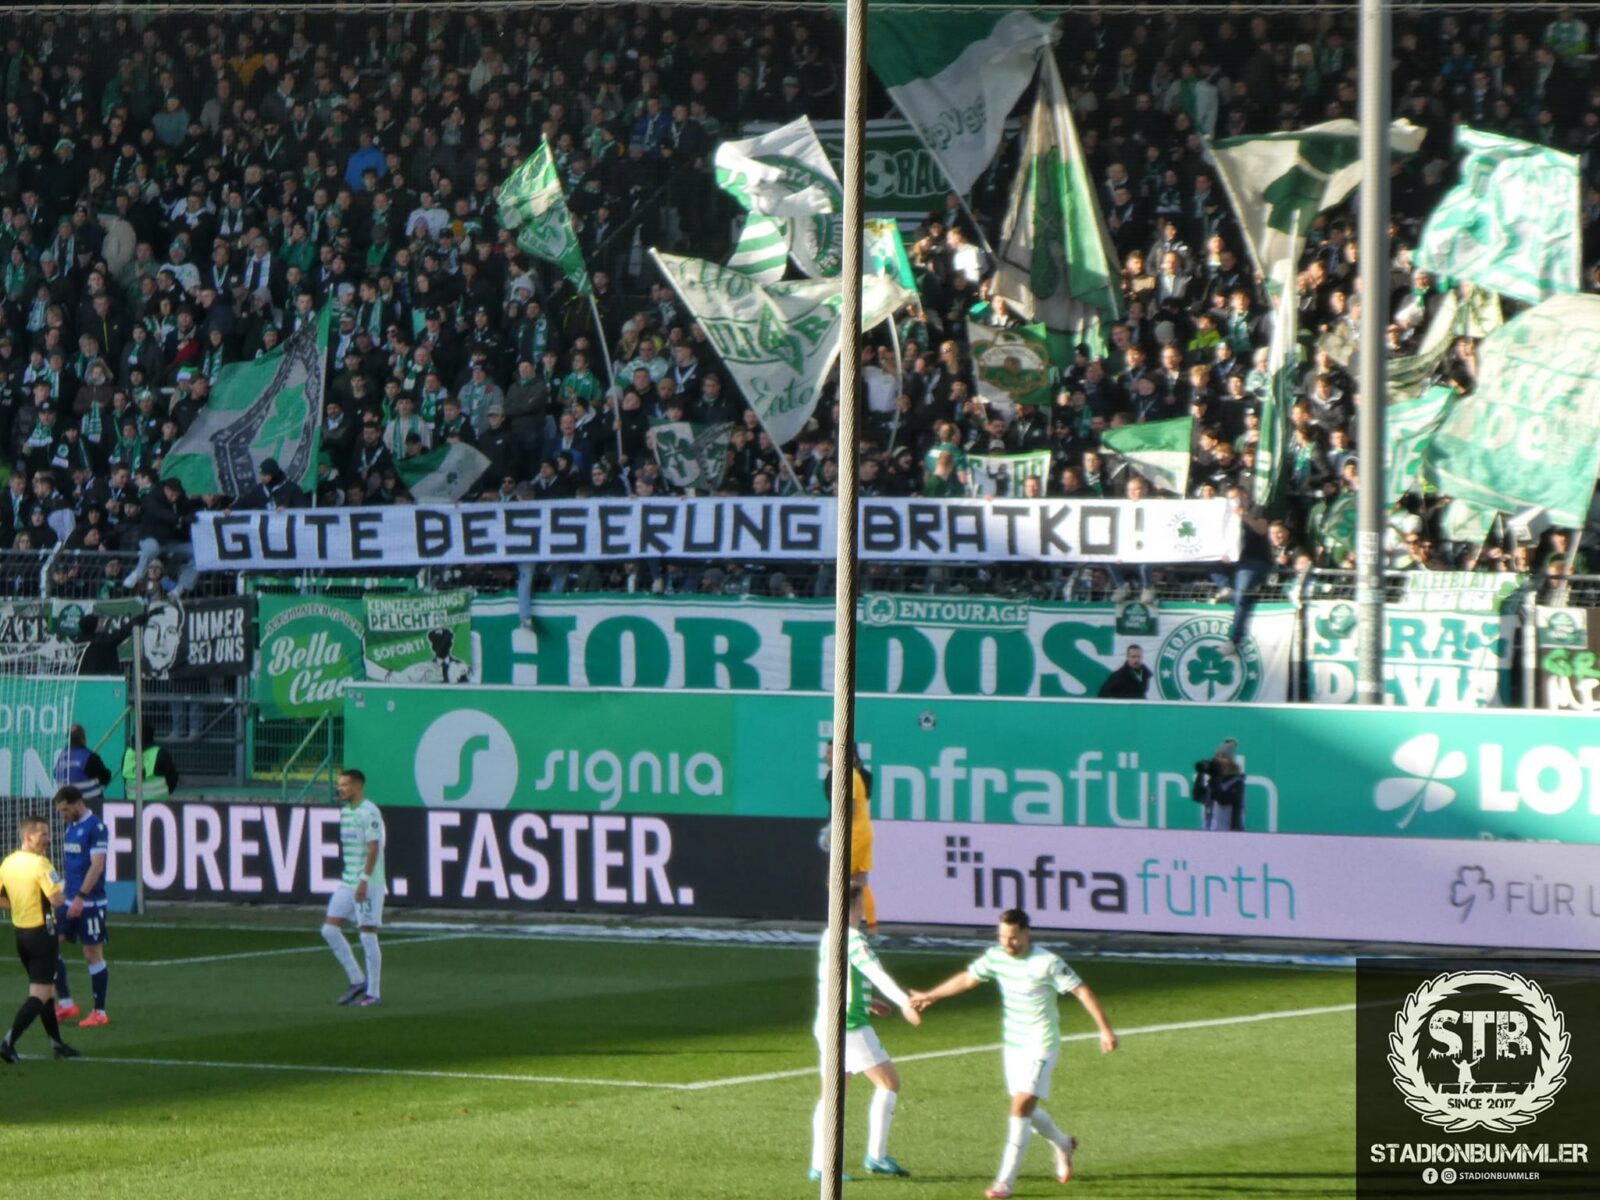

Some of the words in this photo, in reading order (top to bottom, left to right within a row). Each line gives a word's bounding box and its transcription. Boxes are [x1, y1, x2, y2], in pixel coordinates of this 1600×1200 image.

[213, 512, 383, 560] GUTE
[415, 503, 822, 558] BESSERUNG
[863, 504, 1145, 556] BRATKO!
[188, 608, 245, 641] IMMER
[370, 612, 431, 629] PFLICHT
[901, 601, 1028, 623] ENTOURAGE
[214, 637, 245, 664] UNS
[267, 631, 342, 676] Bella
[373, 638, 426, 661] SOFORT!
[471, 613, 1114, 698] HORIDOS
[1163, 620, 1231, 660] HORIDOS
[535, 749, 724, 811] signia
[858, 744, 1065, 826] nfra
[103, 803, 408, 898] FOREVE.
[427, 810, 694, 905] FASTER.
[1136, 858, 1296, 921] fürth
[1505, 873, 1576, 916] FÜR
